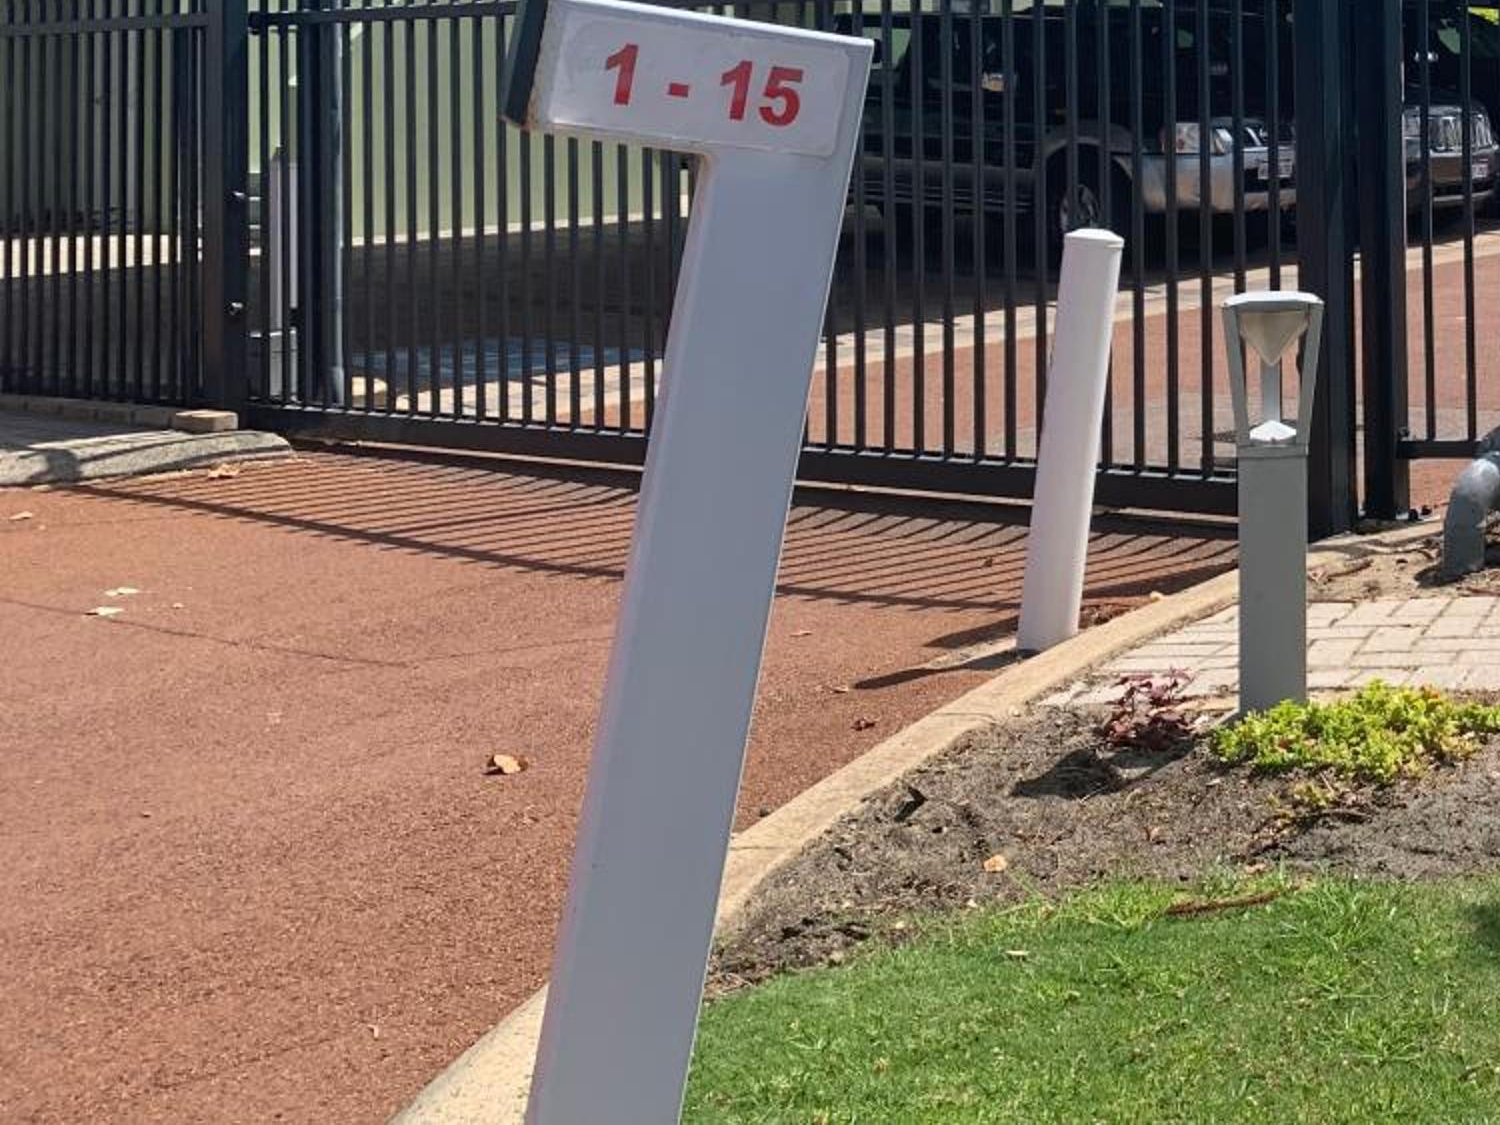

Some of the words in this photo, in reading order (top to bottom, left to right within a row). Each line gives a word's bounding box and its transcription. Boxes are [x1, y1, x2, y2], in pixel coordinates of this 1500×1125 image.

[605, 42, 639, 105] 1
[667, 82, 690, 97] -
[720, 59, 804, 127] 15
